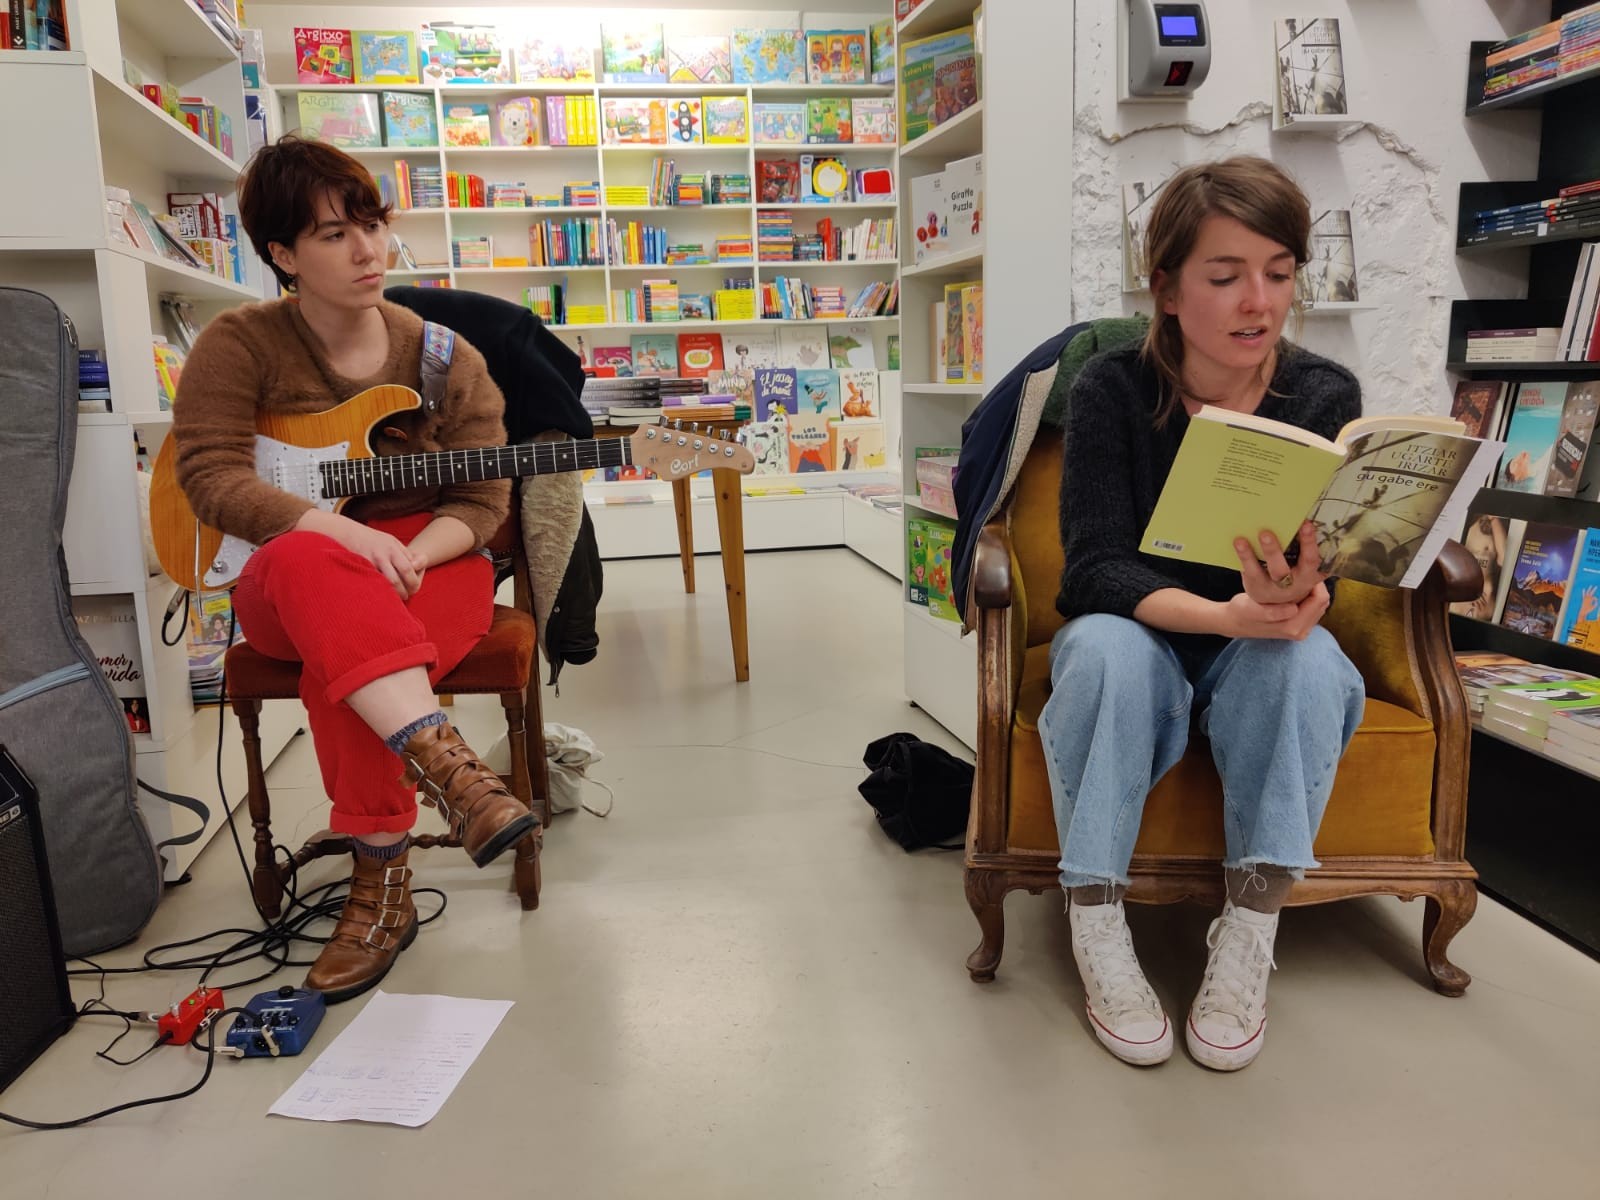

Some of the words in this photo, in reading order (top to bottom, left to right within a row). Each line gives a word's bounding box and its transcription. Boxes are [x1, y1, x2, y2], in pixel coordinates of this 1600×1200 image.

[951, 187, 974, 201] Giraffe
[953, 200, 973, 212] Puzzle
[759, 371, 770, 386] El
[803, 426, 817, 434] LOS
[1407, 444, 1456, 460] ITZIAR
[1392, 452, 1453, 469] UGARTE
[1398, 460, 1448, 477] IRIZAR
[1356, 472, 1375, 482] gu
[1378, 475, 1414, 487] gabe
[1416, 481, 1439, 491] ere
